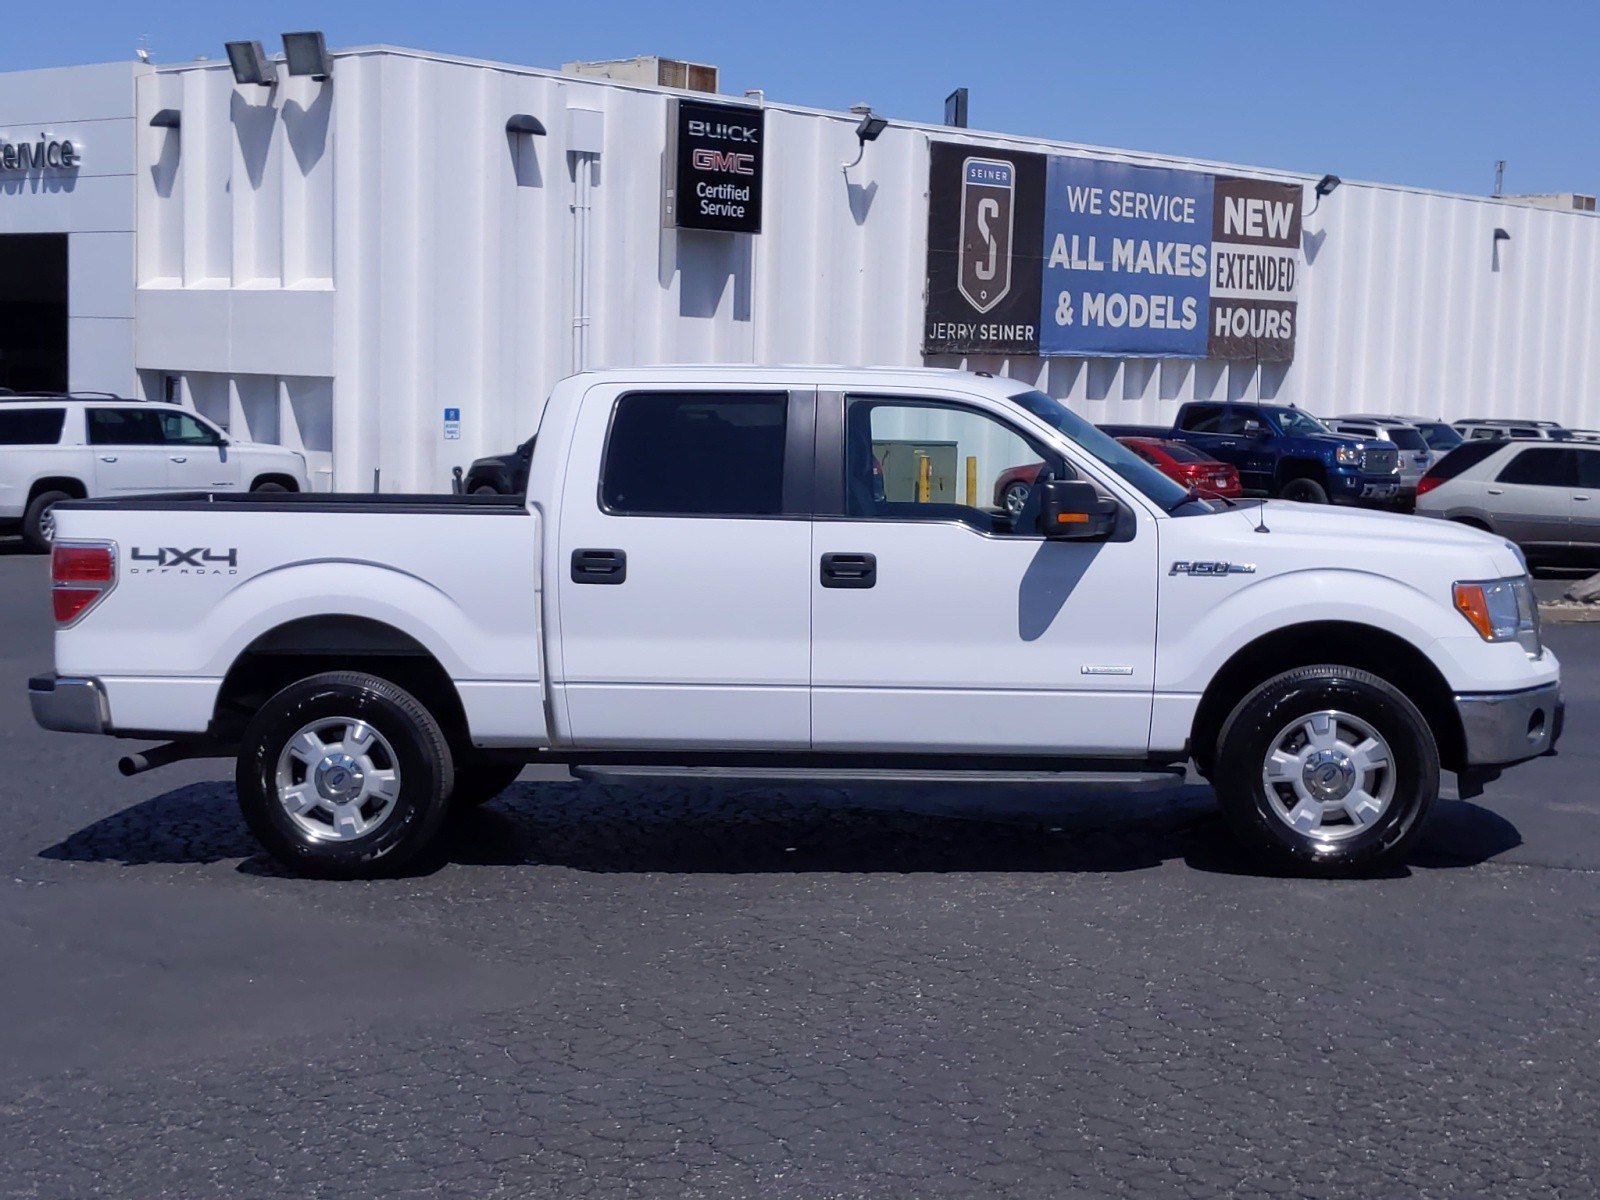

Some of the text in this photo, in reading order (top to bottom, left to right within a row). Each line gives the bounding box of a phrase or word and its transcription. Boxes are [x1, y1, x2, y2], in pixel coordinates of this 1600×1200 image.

[688, 120, 758, 143] BUICK
[0, 132, 81, 170] ervice
[692, 148, 754, 175] GMC
[971, 169, 1007, 180] SEINER
[696, 182, 750, 201] Certified
[1067, 185, 1195, 223] WE SERVICE
[700, 200, 745, 217] Service
[1223, 196, 1293, 239] NEW
[1048, 233, 1207, 277] ALL MAKES
[1216, 252, 1295, 292] EXTENDED
[1055, 290, 1197, 330] & MODELS
[1215, 306, 1292, 339] HOURS
[929, 323, 1034, 341] JERRY SEINER
